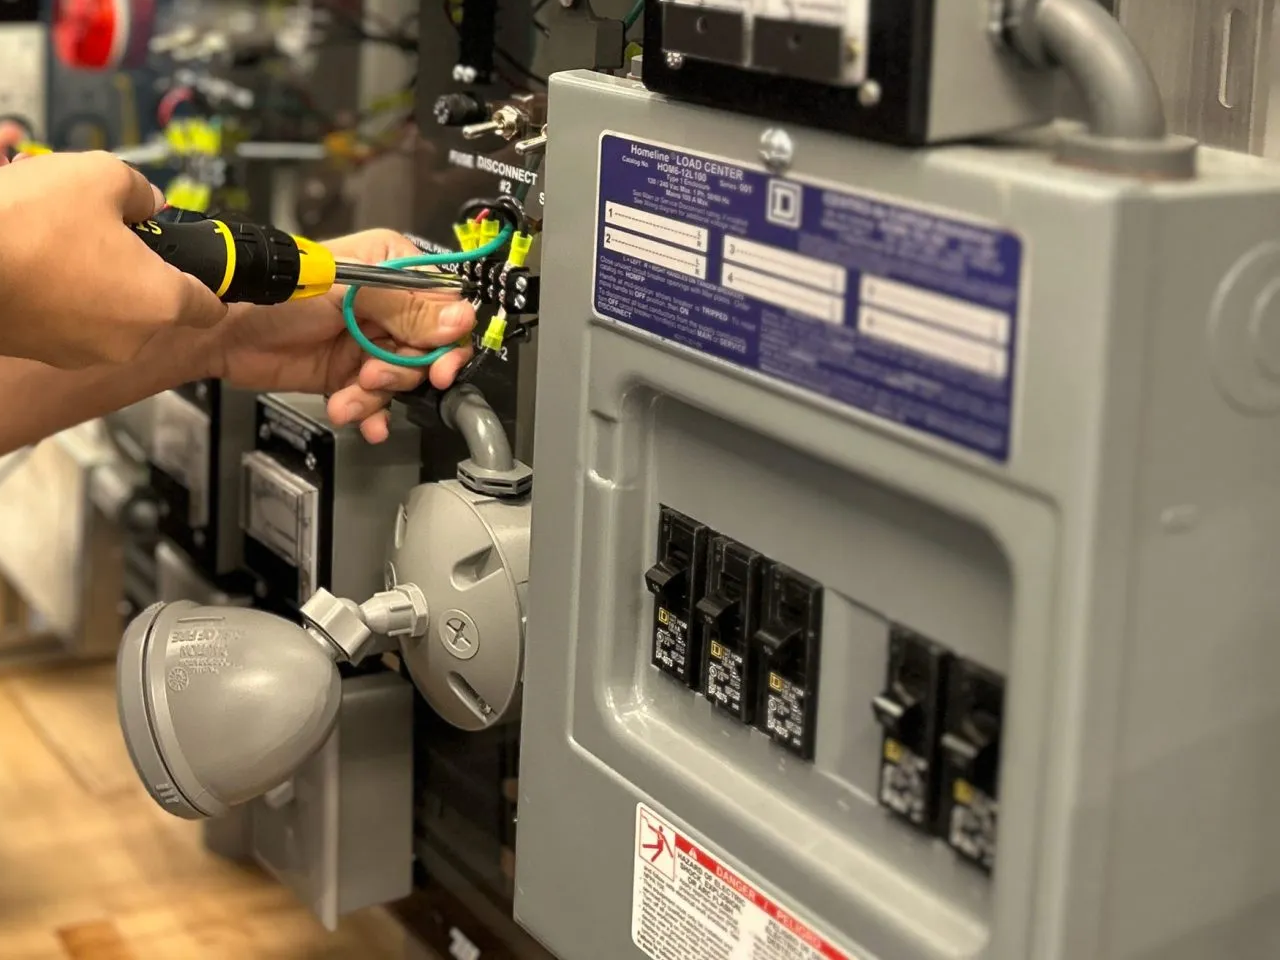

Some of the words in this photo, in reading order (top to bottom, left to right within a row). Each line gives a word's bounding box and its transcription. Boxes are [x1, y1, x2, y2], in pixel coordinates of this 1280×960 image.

[477, 155, 538, 186] DISCONNECT
[622, 155, 640, 168] Catalog
[631, 144, 670, 162] Homeline
[676, 155, 703, 171] LOAD
[704, 163, 744, 181] CENTER
[500, 180, 511, 194] #2
[606, 233, 611, 243] 2
[608, 297, 618, 306] OFF
[634, 290, 645, 300] OFF
[679, 306, 688, 315] ON
[677, 853, 703, 876] HAZARD
[705, 869, 713, 881] OF
[714, 878, 746, 908] ELECTRIC
[688, 875, 697, 887] OR
[698, 882, 711, 898] ARC
[715, 866, 756, 901] DANGER
[776, 910, 821, 949] PELIGRO
